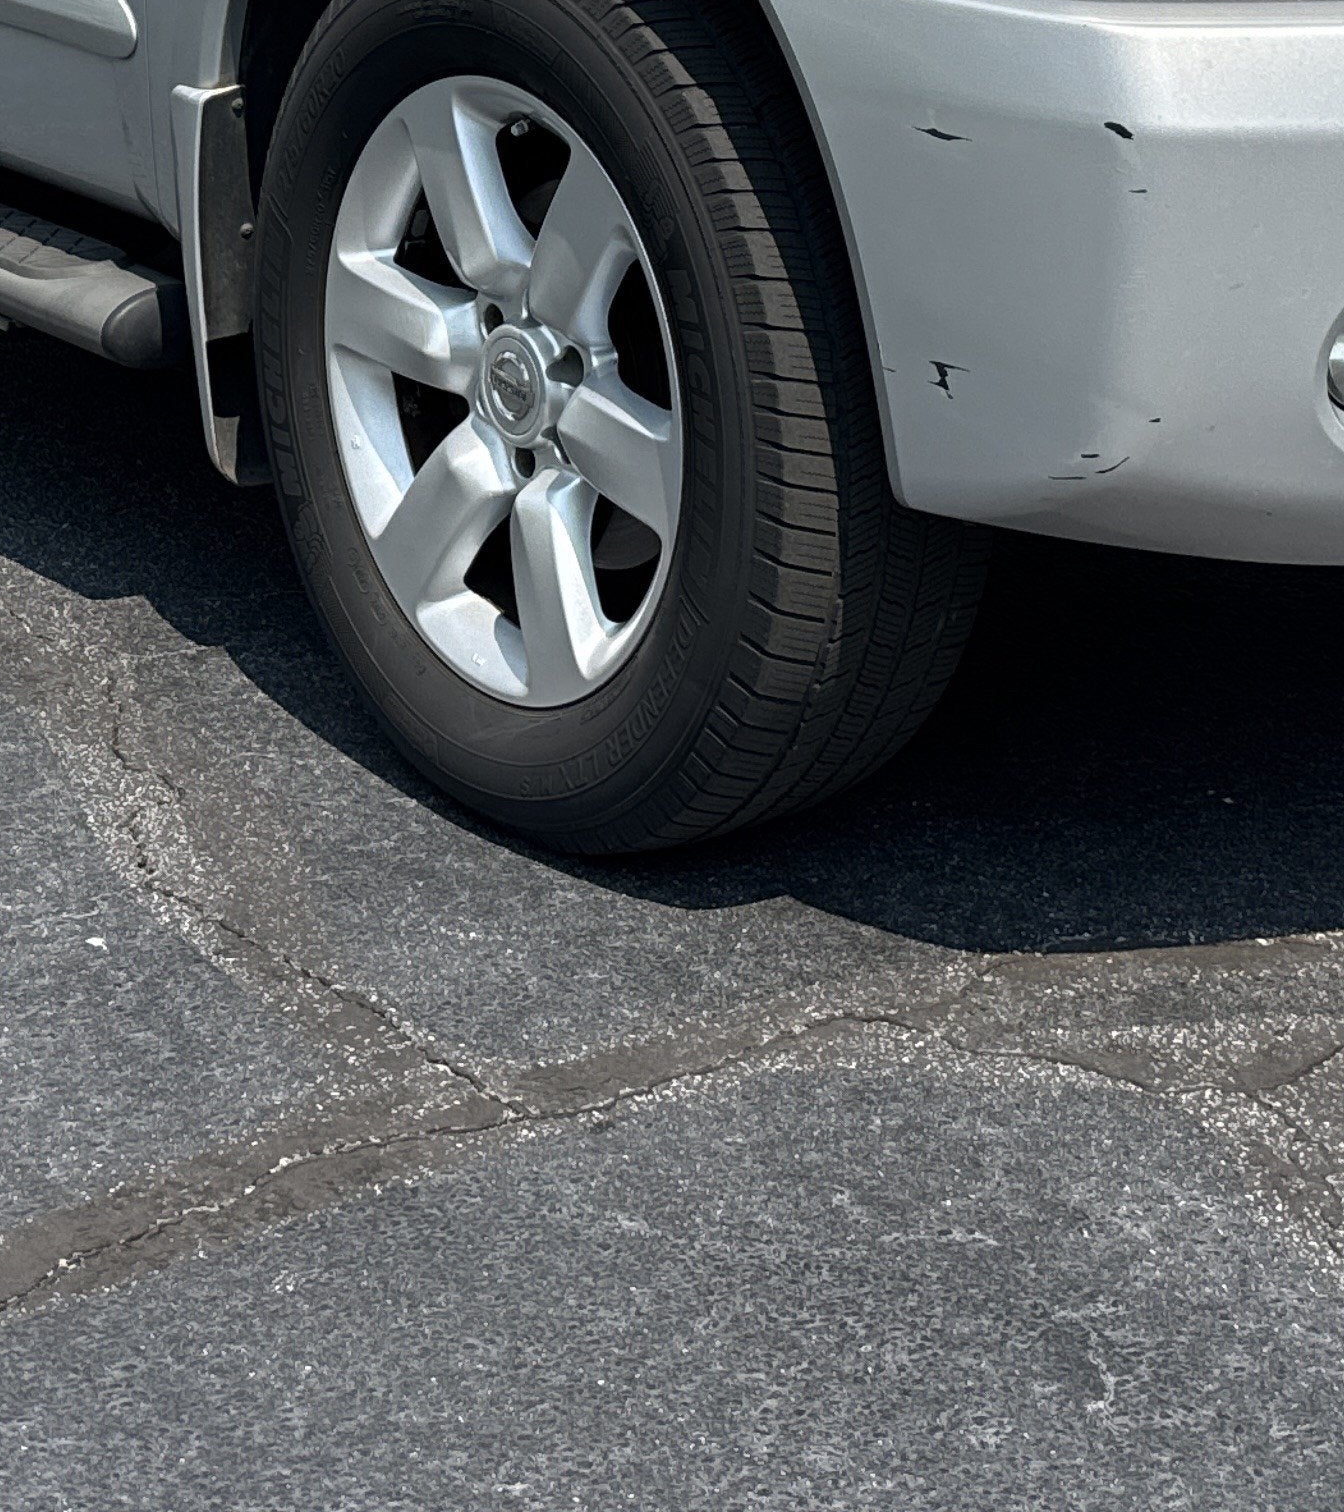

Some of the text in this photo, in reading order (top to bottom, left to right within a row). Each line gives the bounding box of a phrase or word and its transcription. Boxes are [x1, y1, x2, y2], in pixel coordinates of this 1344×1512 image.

[259, 224, 306, 497] MICHELIN
[667, 268, 723, 584] MICHELIN
[607, 611, 695, 766] DEFENDER
